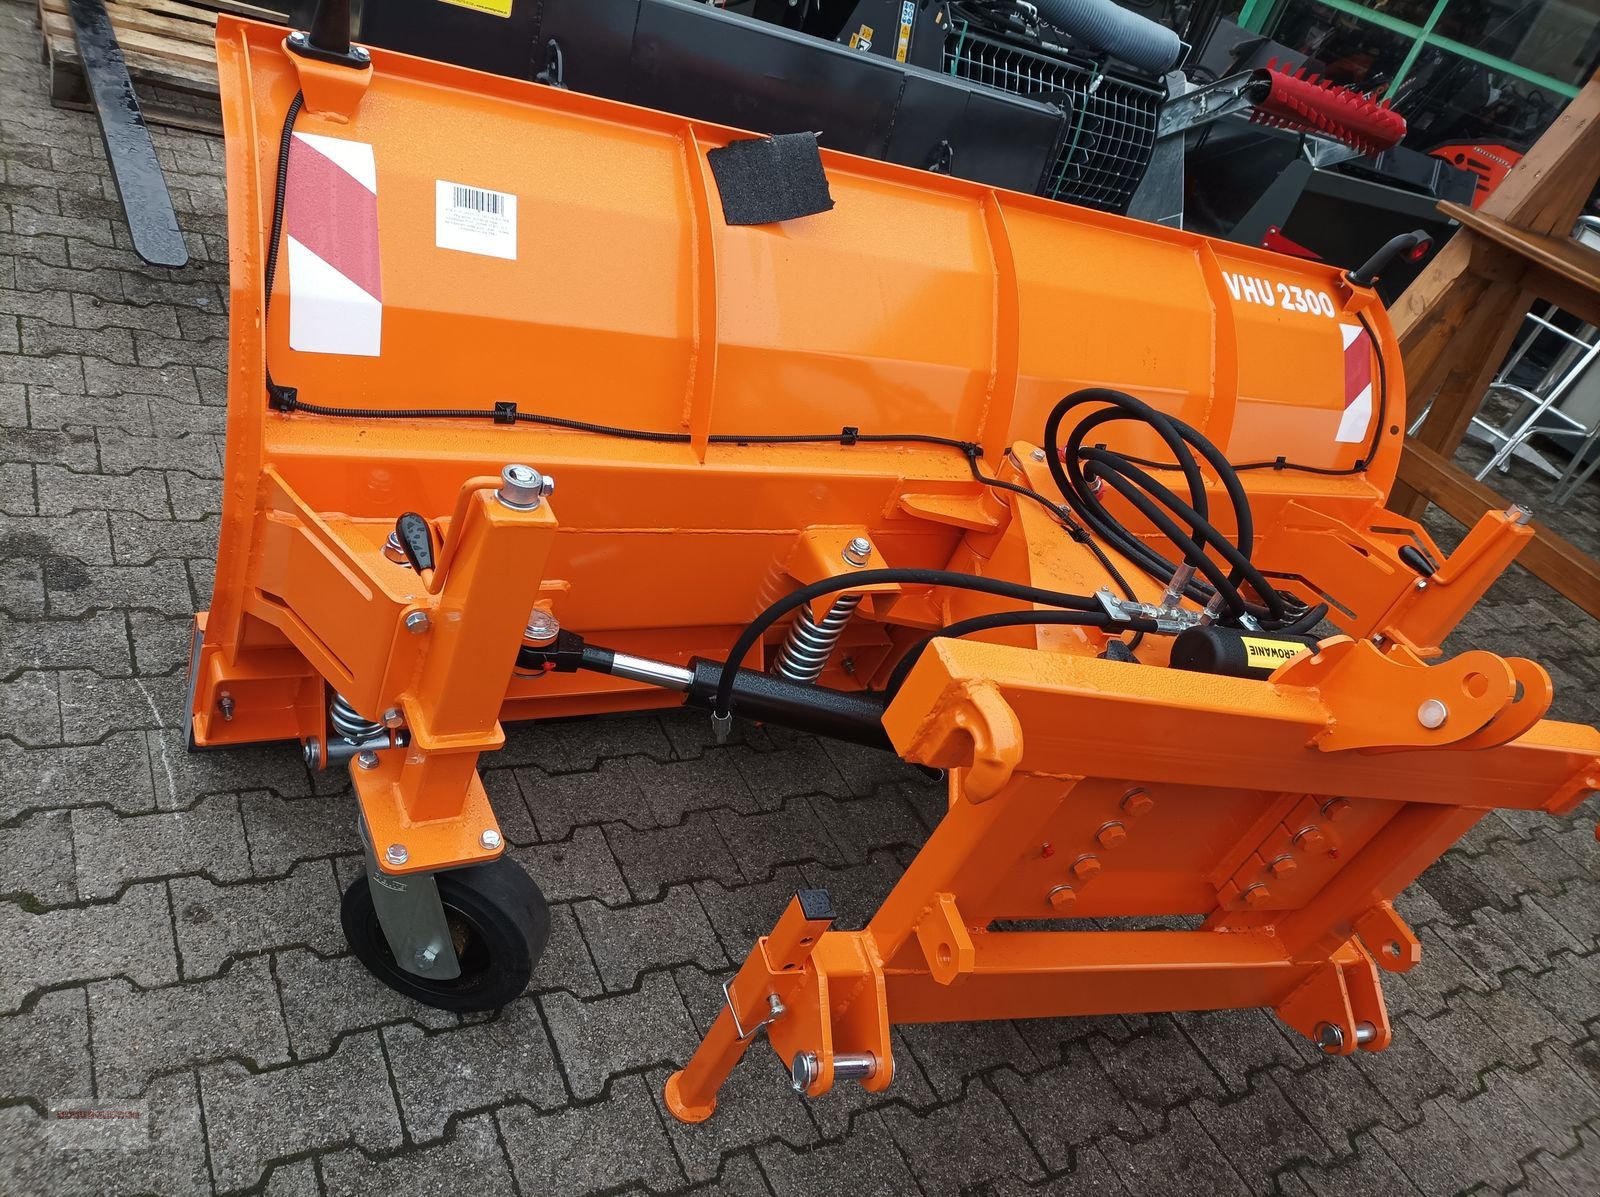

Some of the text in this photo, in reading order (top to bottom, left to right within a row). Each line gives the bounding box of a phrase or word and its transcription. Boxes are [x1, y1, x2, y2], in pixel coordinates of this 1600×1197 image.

[1221, 271, 1336, 318] VHU 2300
[1250, 645, 1299, 659] EROWANIE
